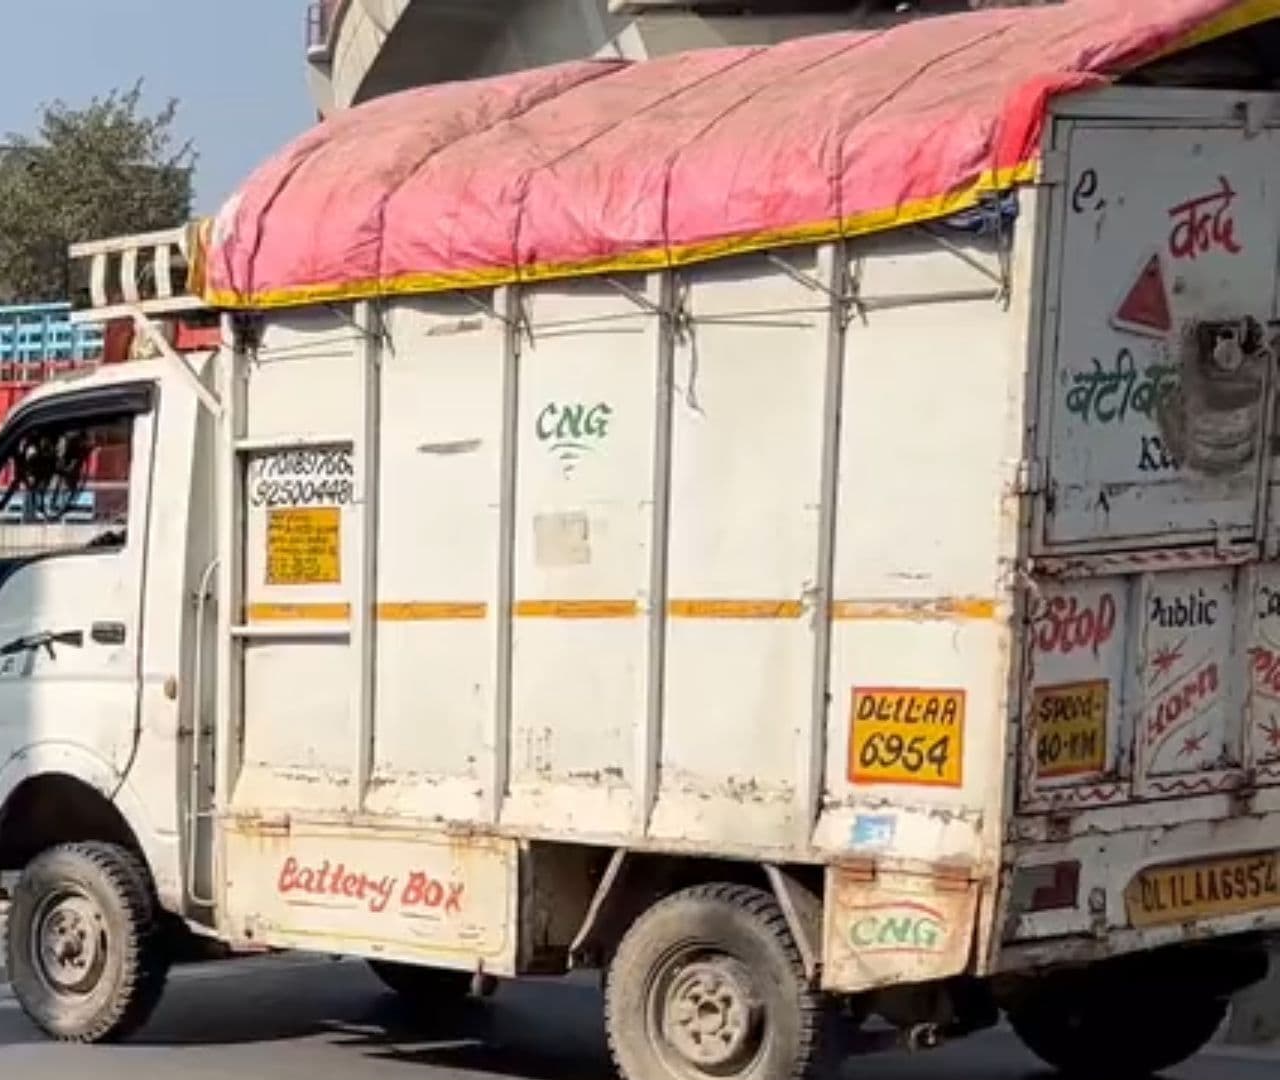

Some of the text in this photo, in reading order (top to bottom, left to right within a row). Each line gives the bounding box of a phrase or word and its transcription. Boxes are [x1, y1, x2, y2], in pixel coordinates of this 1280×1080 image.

[536, 401, 613, 442] CNG
[1029, 592, 1116, 653] Stop
[859, 731, 950, 777] 6954
[277, 856, 465, 914] Battery Box
[849, 917, 940, 947] CNG
